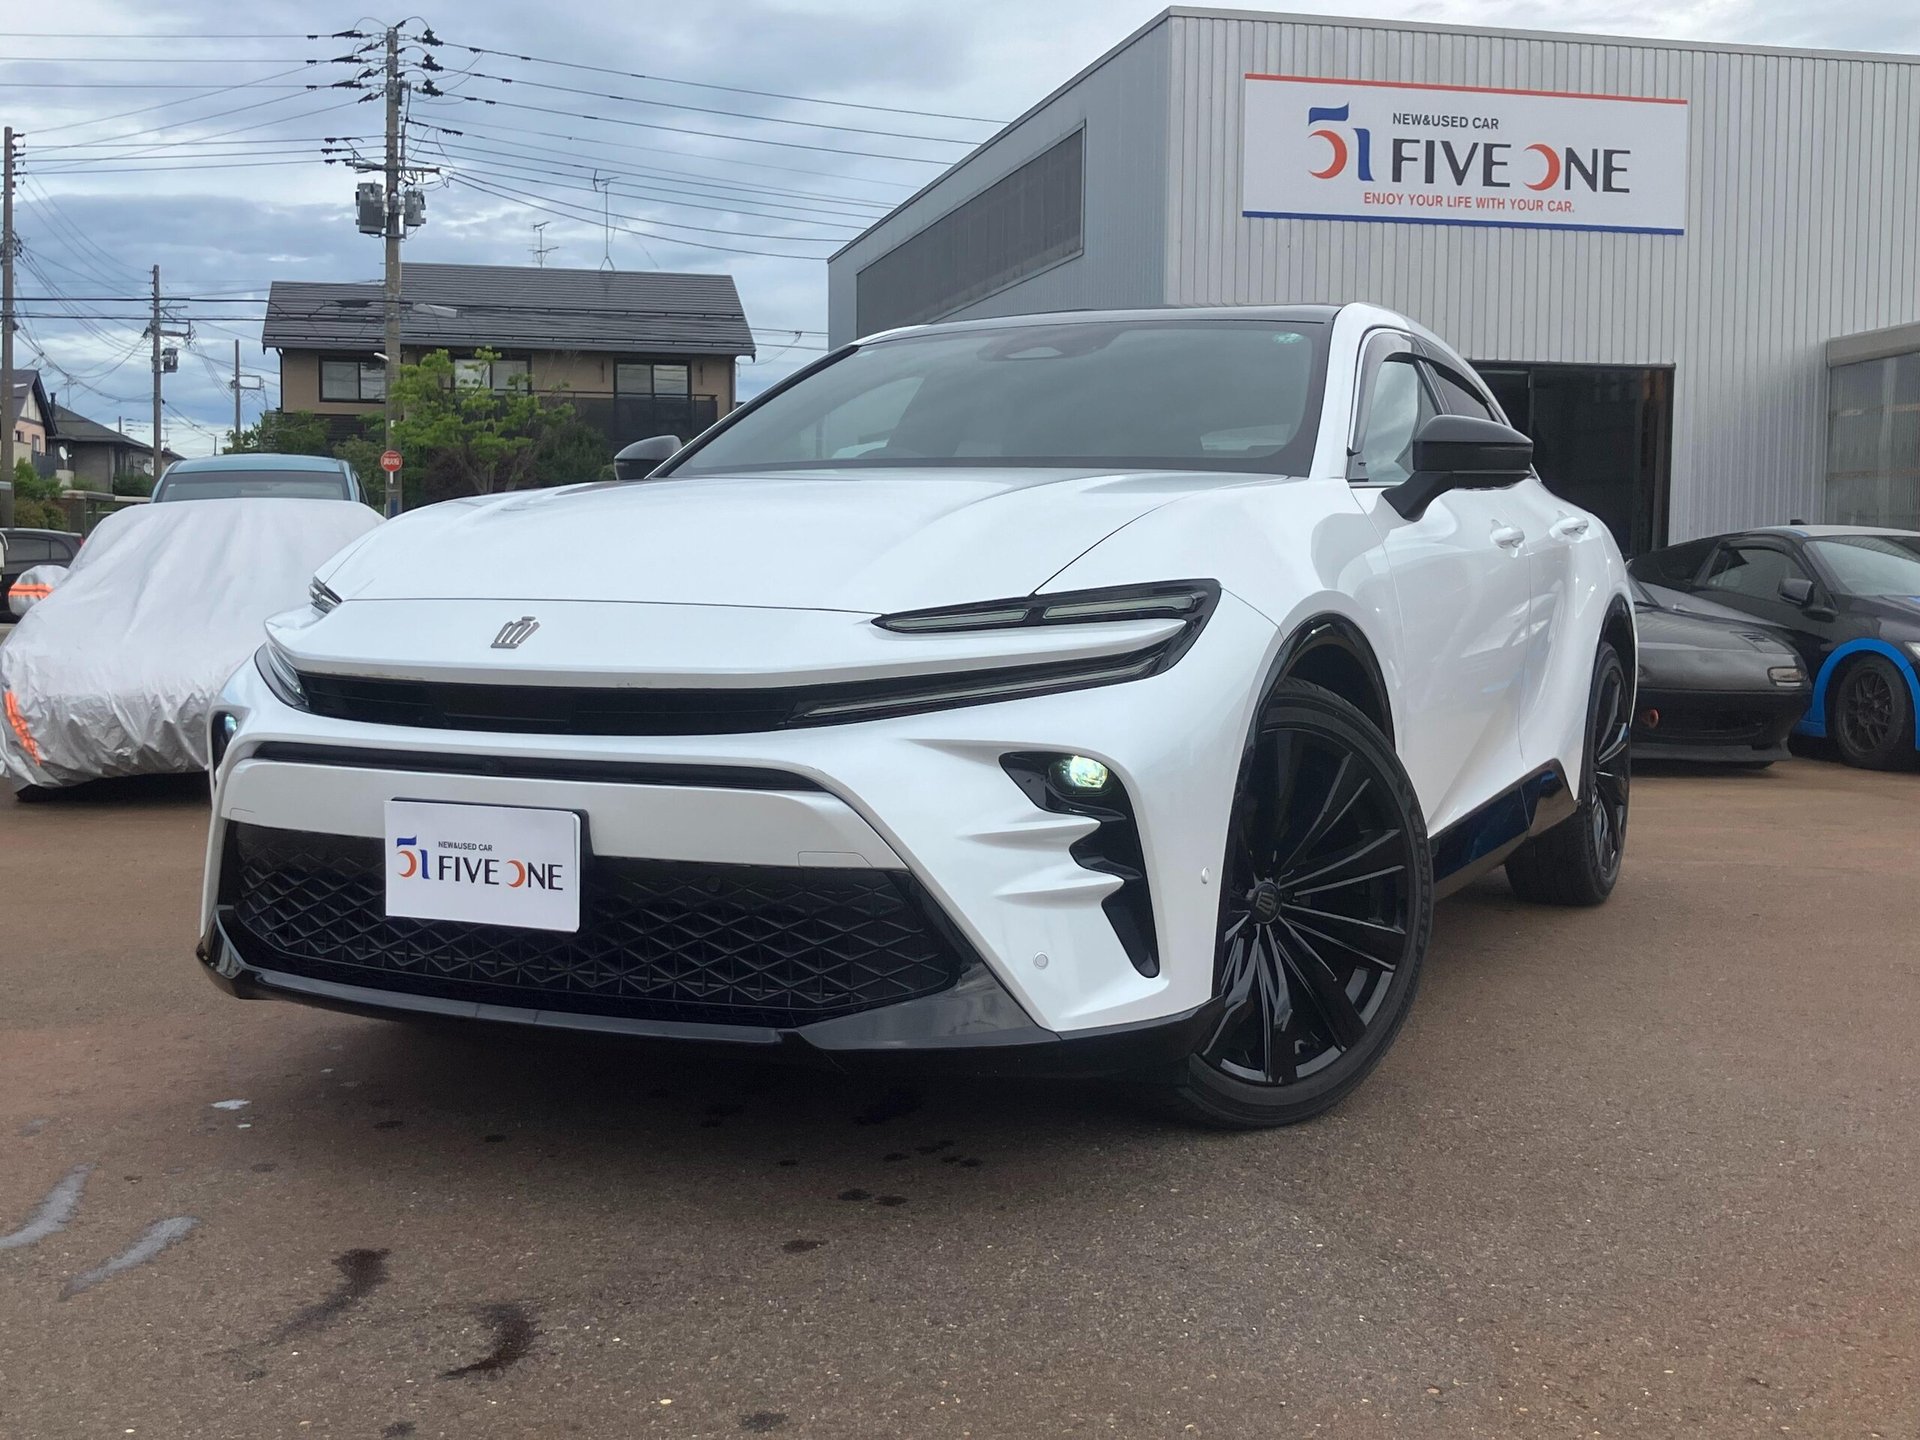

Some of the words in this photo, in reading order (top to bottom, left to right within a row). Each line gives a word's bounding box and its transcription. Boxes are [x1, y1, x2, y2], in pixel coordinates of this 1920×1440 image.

[1392, 112, 1468, 128] NEW&USED
[1472, 117, 1499, 129] CAR
[1308, 102, 1374, 180] 51
[1392, 138, 1512, 188] FIVE
[1523, 143, 1631, 194] ONE
[1364, 192, 1404, 205] ENJOY
[1408, 194, 1443, 207] YOUR
[1447, 196, 1472, 208] LIFE
[1475, 197, 1505, 210] WITH
[1510, 199, 1543, 212] YOUR
[1547, 201, 1575, 213] CAR.
[396, 834, 430, 880] 51
[438, 841, 477, 851] NEW&USED
[439, 855, 500, 885] FIVE
[505, 859, 563, 891] ONE
